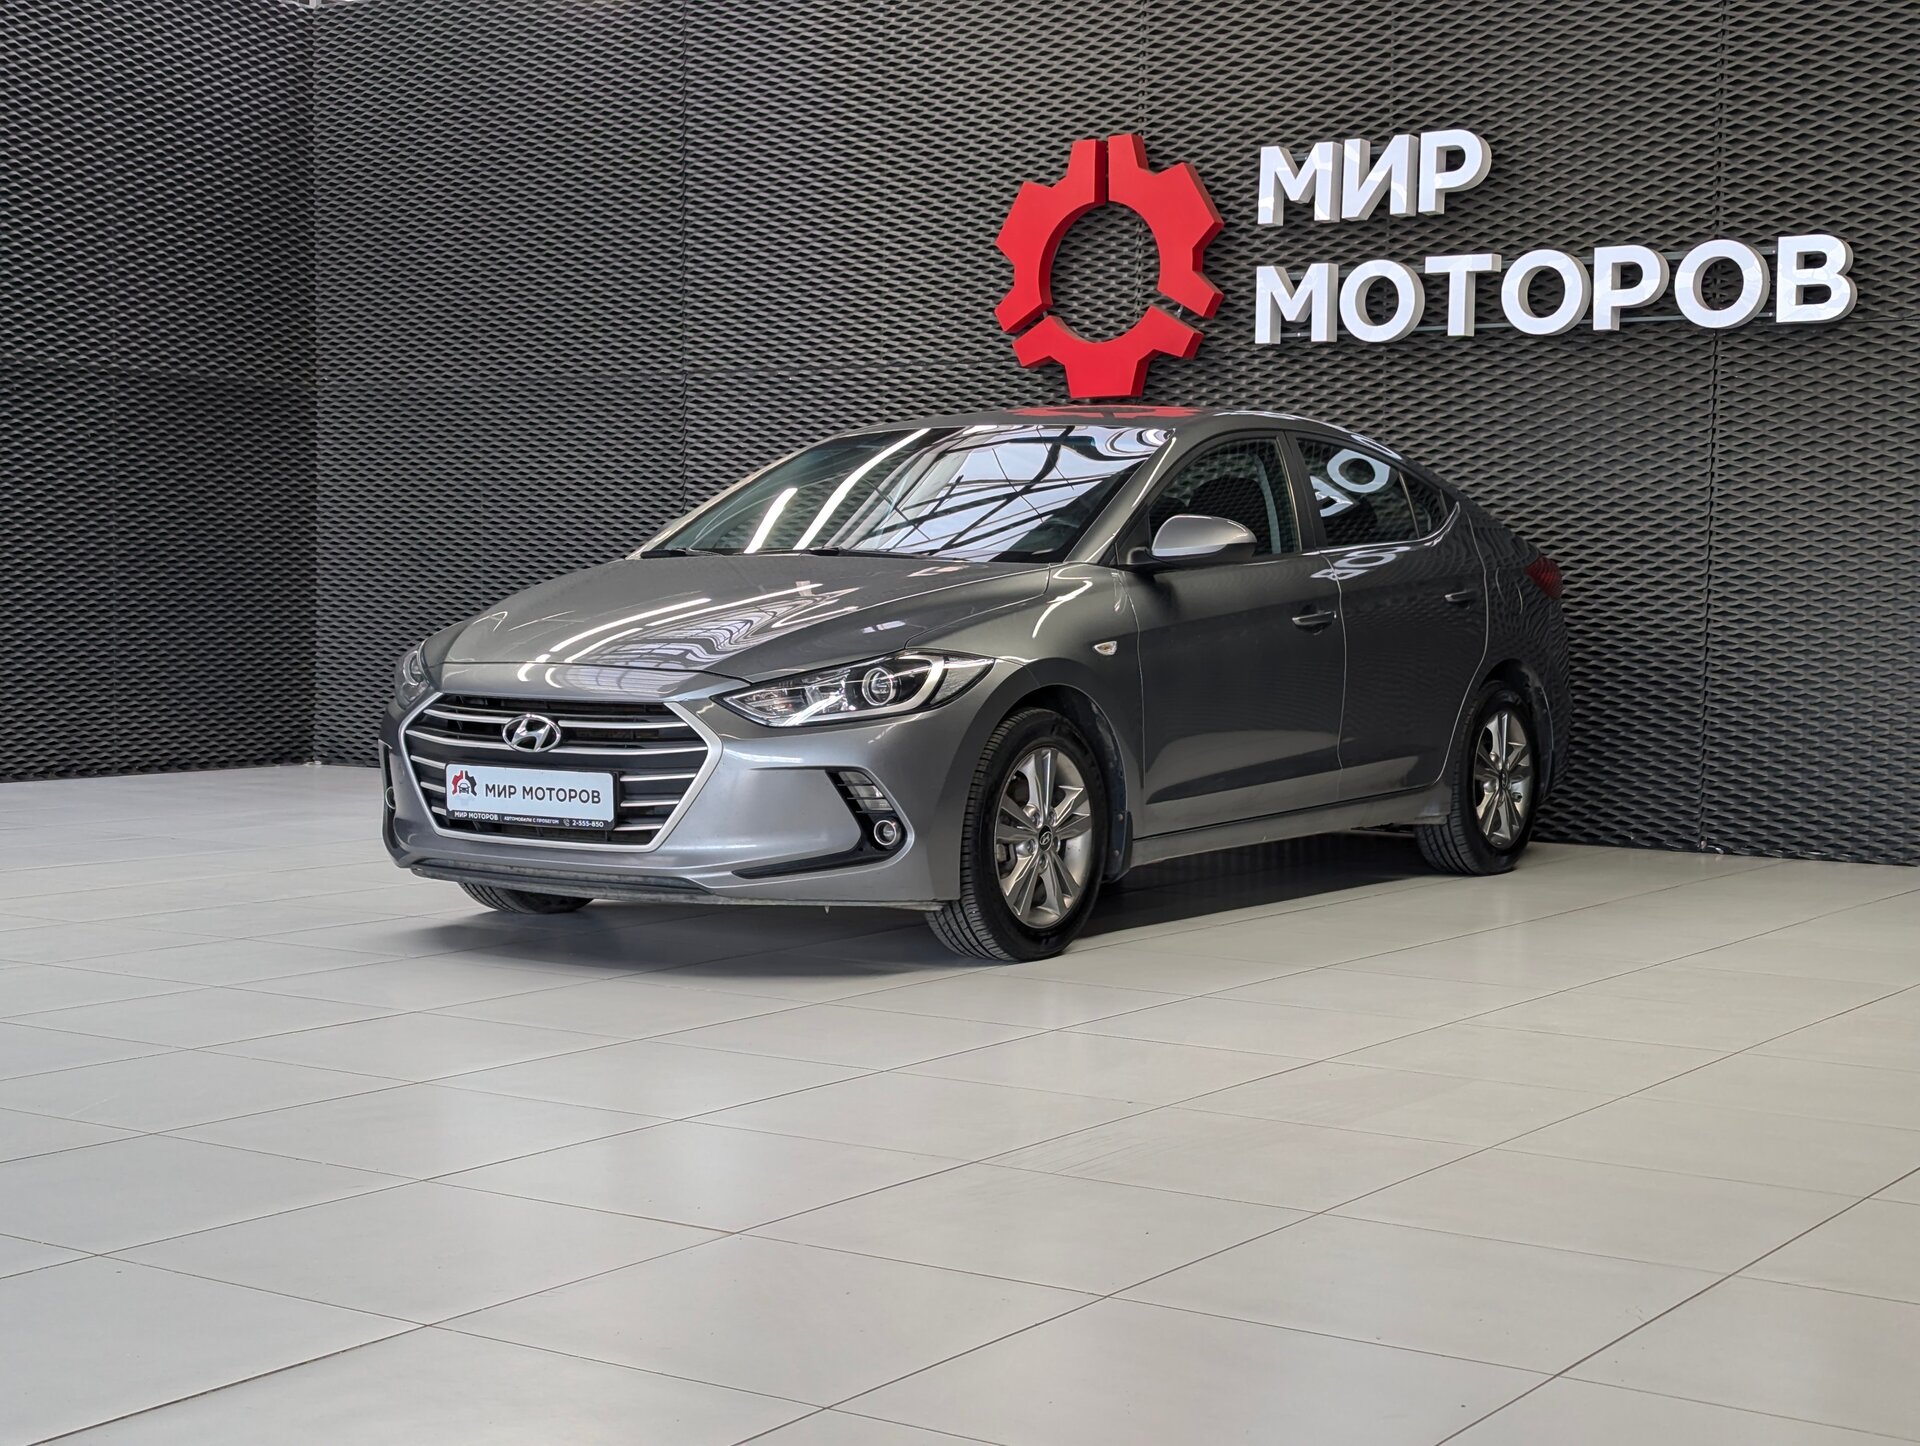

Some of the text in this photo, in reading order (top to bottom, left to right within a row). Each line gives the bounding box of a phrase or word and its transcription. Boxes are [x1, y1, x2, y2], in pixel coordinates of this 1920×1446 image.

[1257, 129, 1492, 226] МИР
[1255, 233, 1857, 344] МОТОРОВ
[468, 812, 499, 821] МОТОРОВ
[572, 820, 604, 828] 2-555-850
[485, 783, 601, 804] МИР МОТОРОВ
